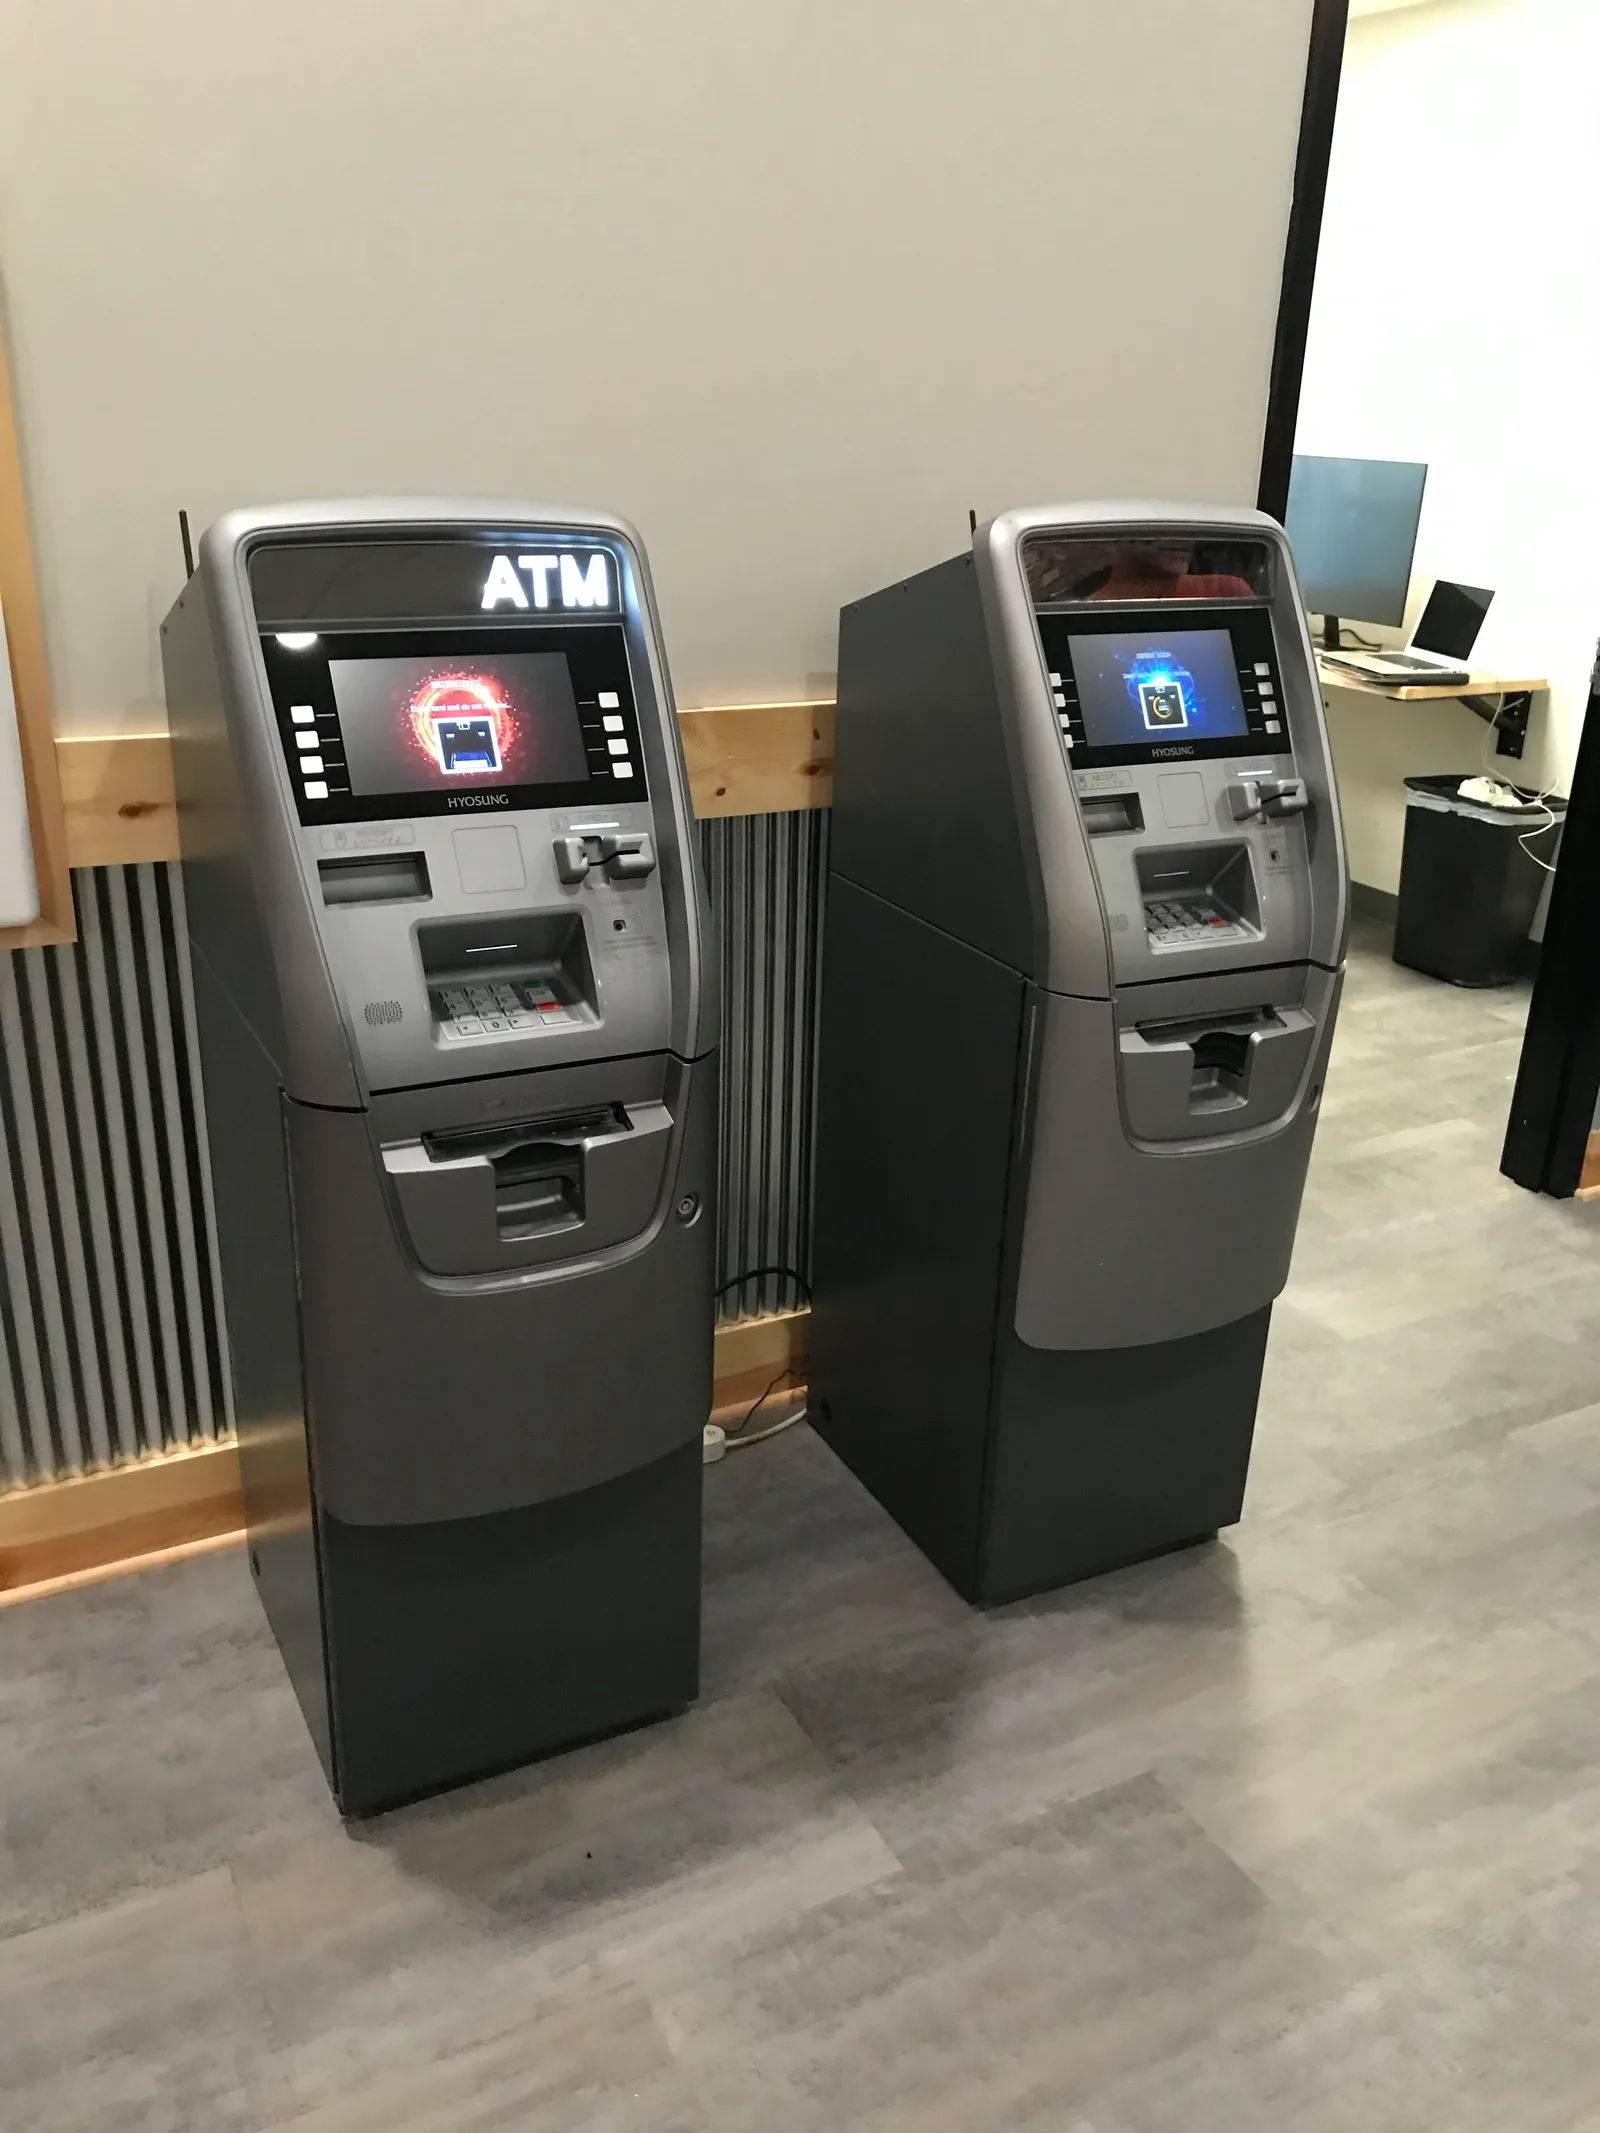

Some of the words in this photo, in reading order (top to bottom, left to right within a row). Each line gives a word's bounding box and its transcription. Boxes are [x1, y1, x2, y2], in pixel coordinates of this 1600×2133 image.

[481, 554, 609, 609] ATM
[1151, 746, 1194, 758] HYOSUNG
[447, 794, 509, 808] HYOSUNG
